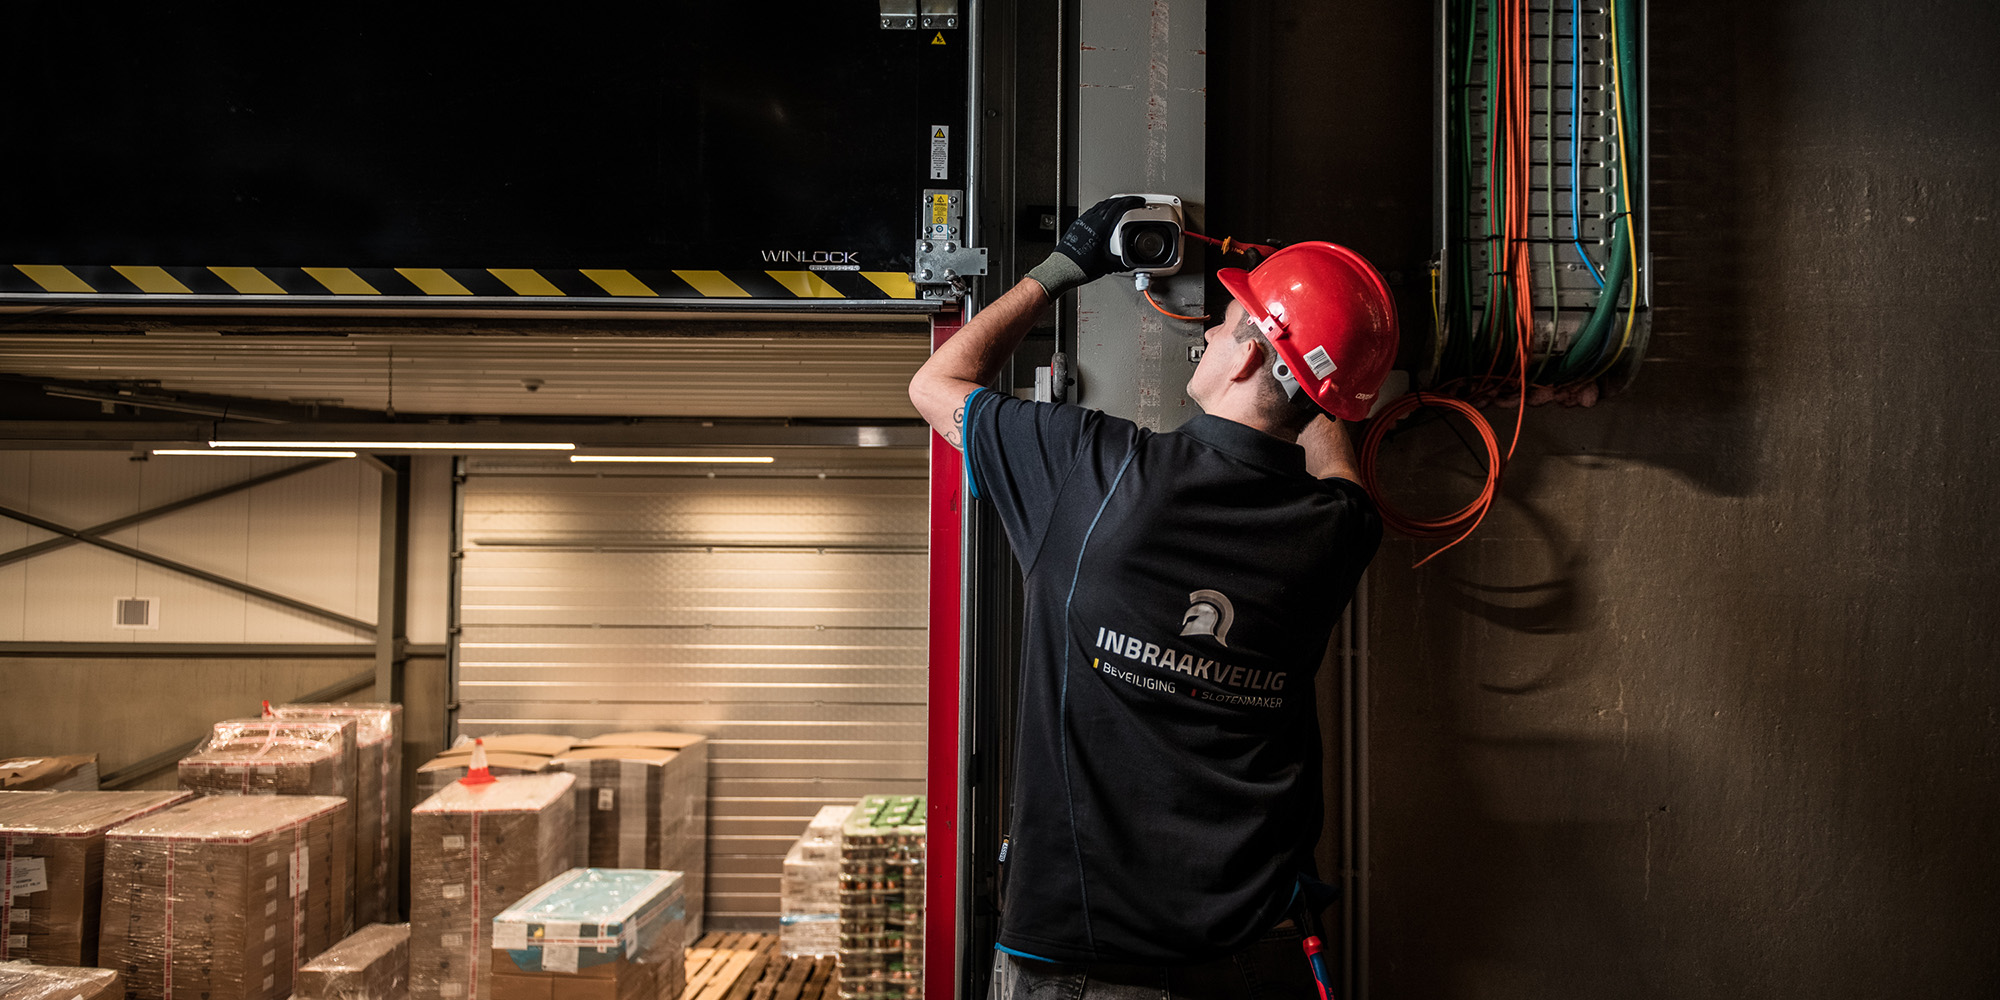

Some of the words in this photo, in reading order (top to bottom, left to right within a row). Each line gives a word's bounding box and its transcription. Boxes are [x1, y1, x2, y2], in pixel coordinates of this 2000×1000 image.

[761, 250, 860, 264] WINLOCK
[1095, 626, 1287, 691] INBRAAKVEILIG
[1102, 661, 1176, 694] BEVEILIGING
[1201, 691, 1283, 708] SLOTENMAKER
